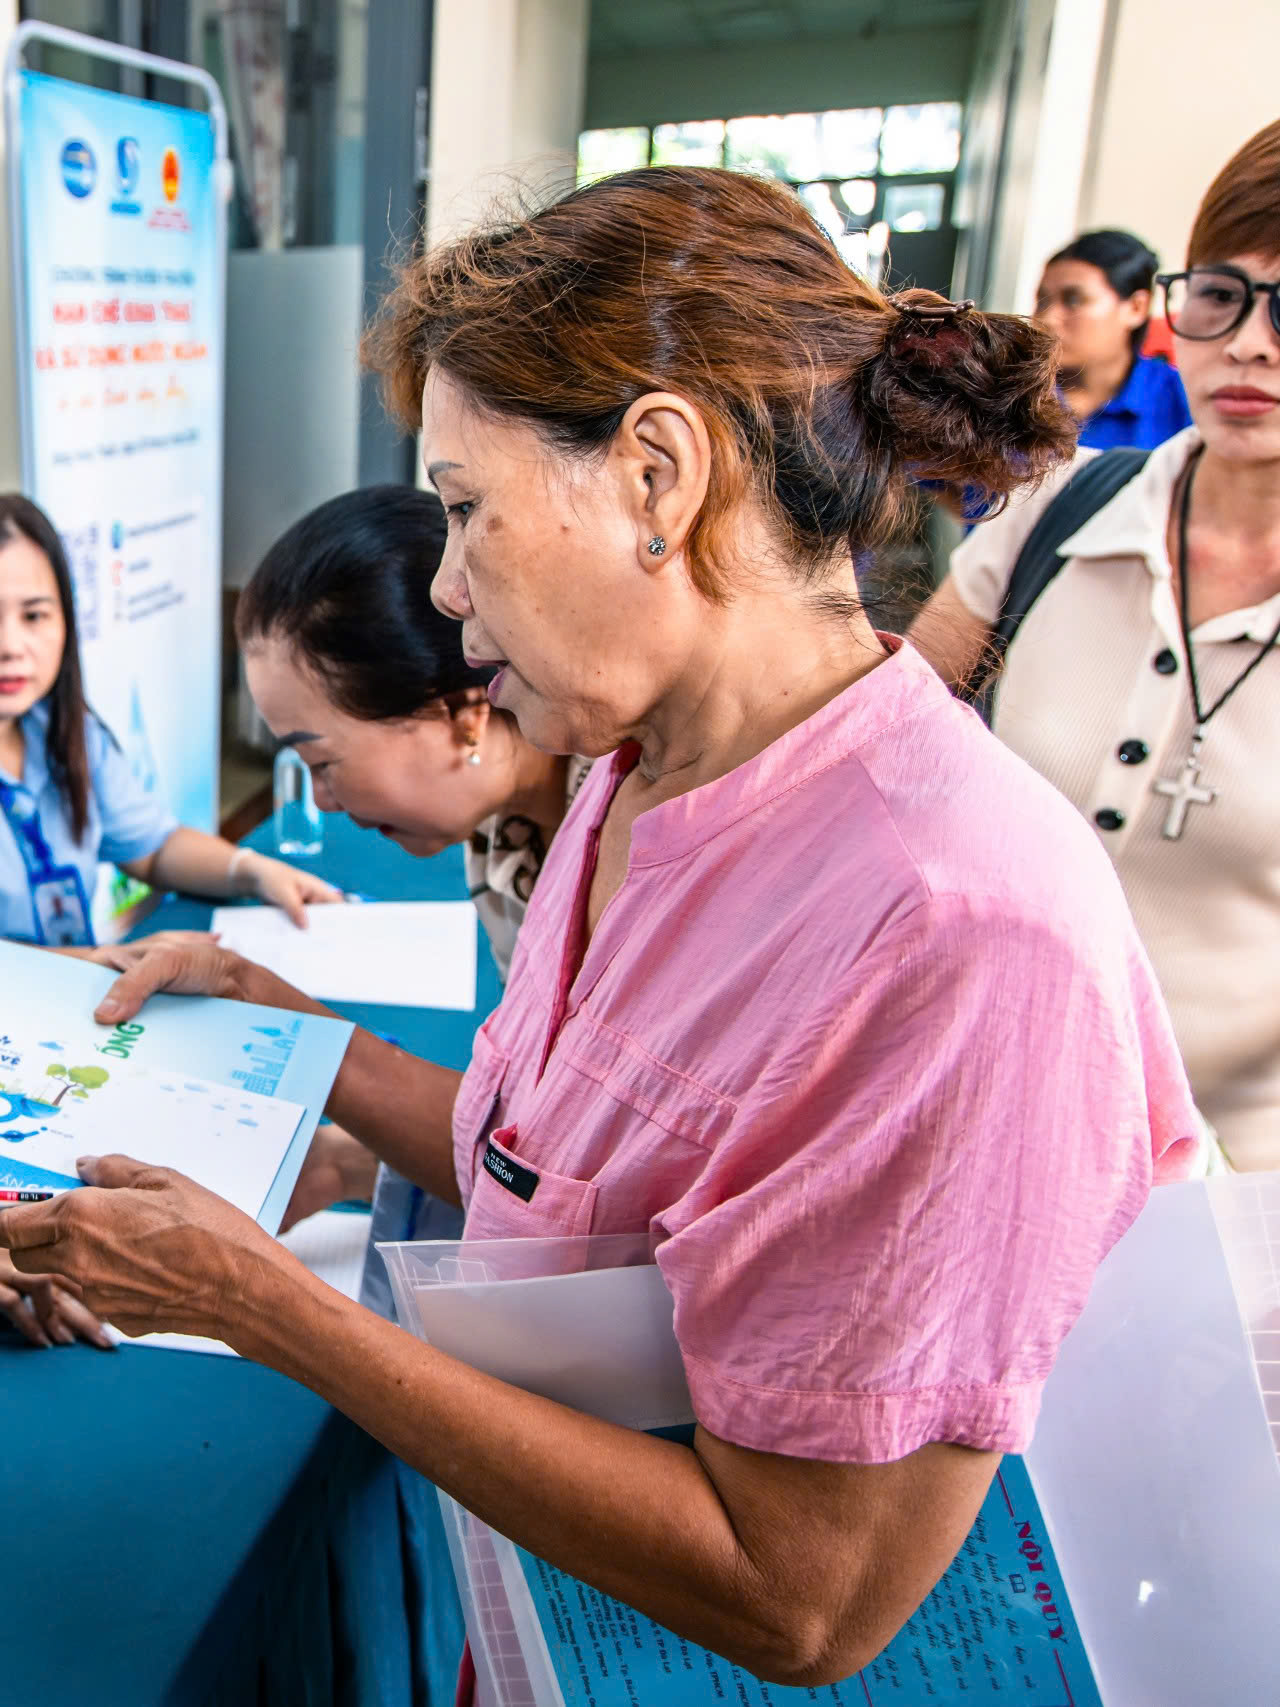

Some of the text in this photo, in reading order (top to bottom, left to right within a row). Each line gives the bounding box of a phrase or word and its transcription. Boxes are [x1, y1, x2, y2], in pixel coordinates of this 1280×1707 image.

[490, 1153, 507, 1169] NEW
[1013, 1519, 1068, 1645] NỘI QUY
